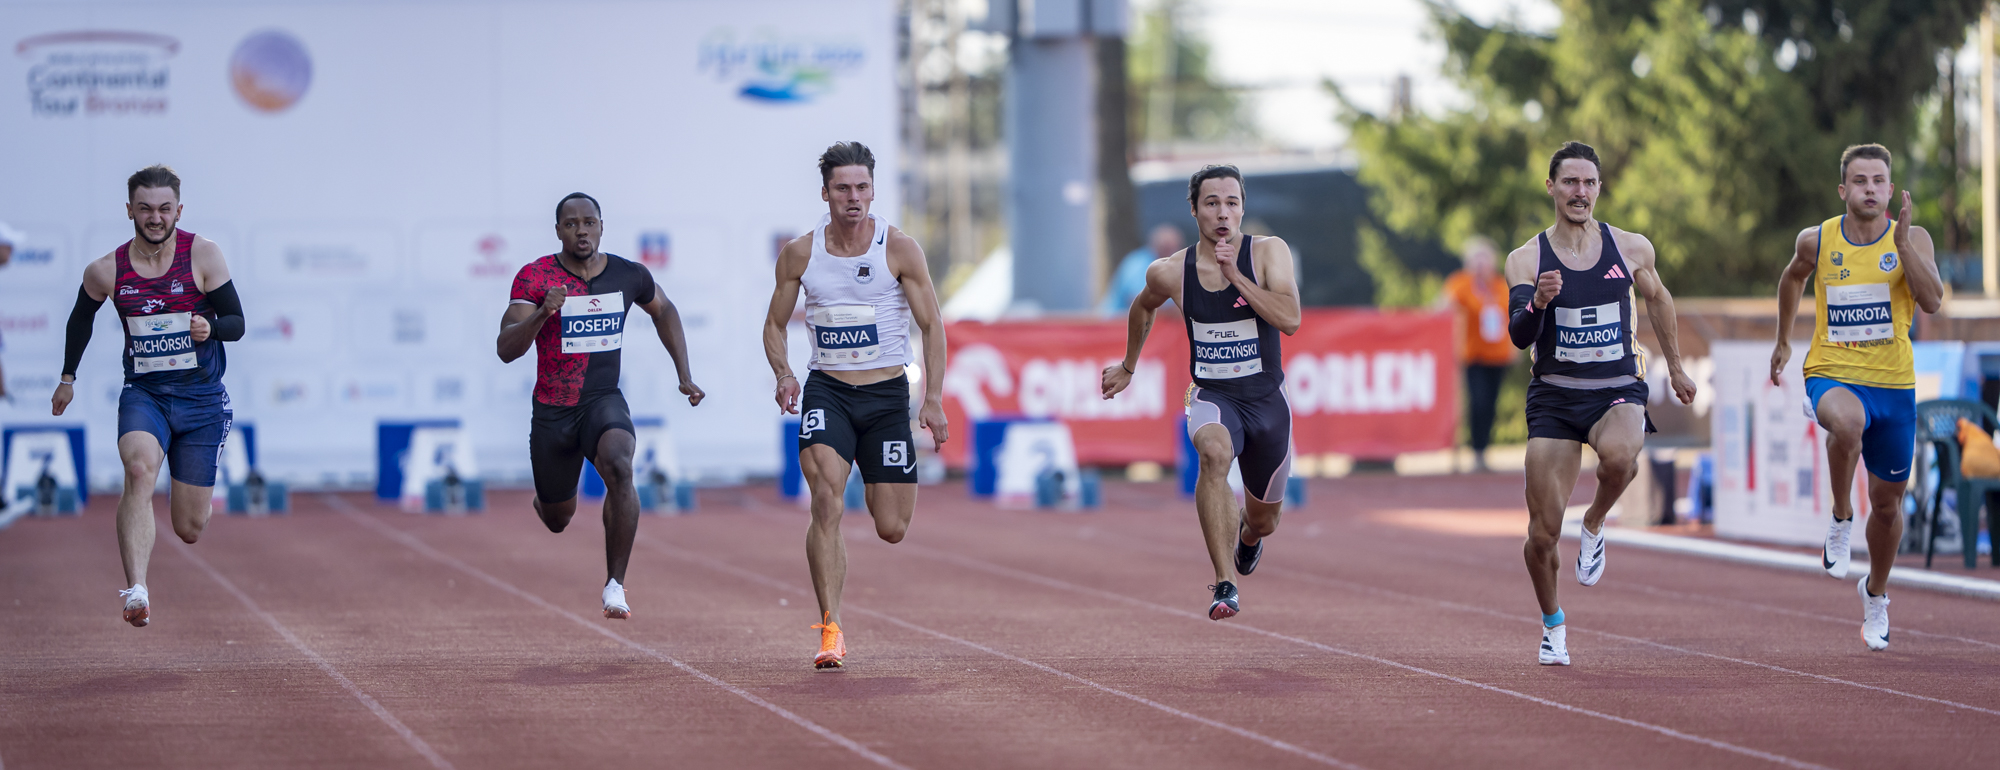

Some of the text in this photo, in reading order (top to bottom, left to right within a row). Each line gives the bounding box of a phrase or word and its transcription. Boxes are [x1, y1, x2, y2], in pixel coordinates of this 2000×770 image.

[1829, 306, 1890, 323] WYKROTA
[565, 316, 621, 334] JOSEPH
[821, 330, 871, 345] GRAVA
[1214, 330, 1240, 339] FUEL
[1560, 326, 1619, 345] NAZAROV
[133, 335, 192, 354] BACHÓRSKI
[1196, 342, 1258, 360] BOGACZYŃSKI
[1286, 351, 1437, 416] ORLEN
[806, 410, 820, 429] 5
[888, 442, 902, 464] 5
